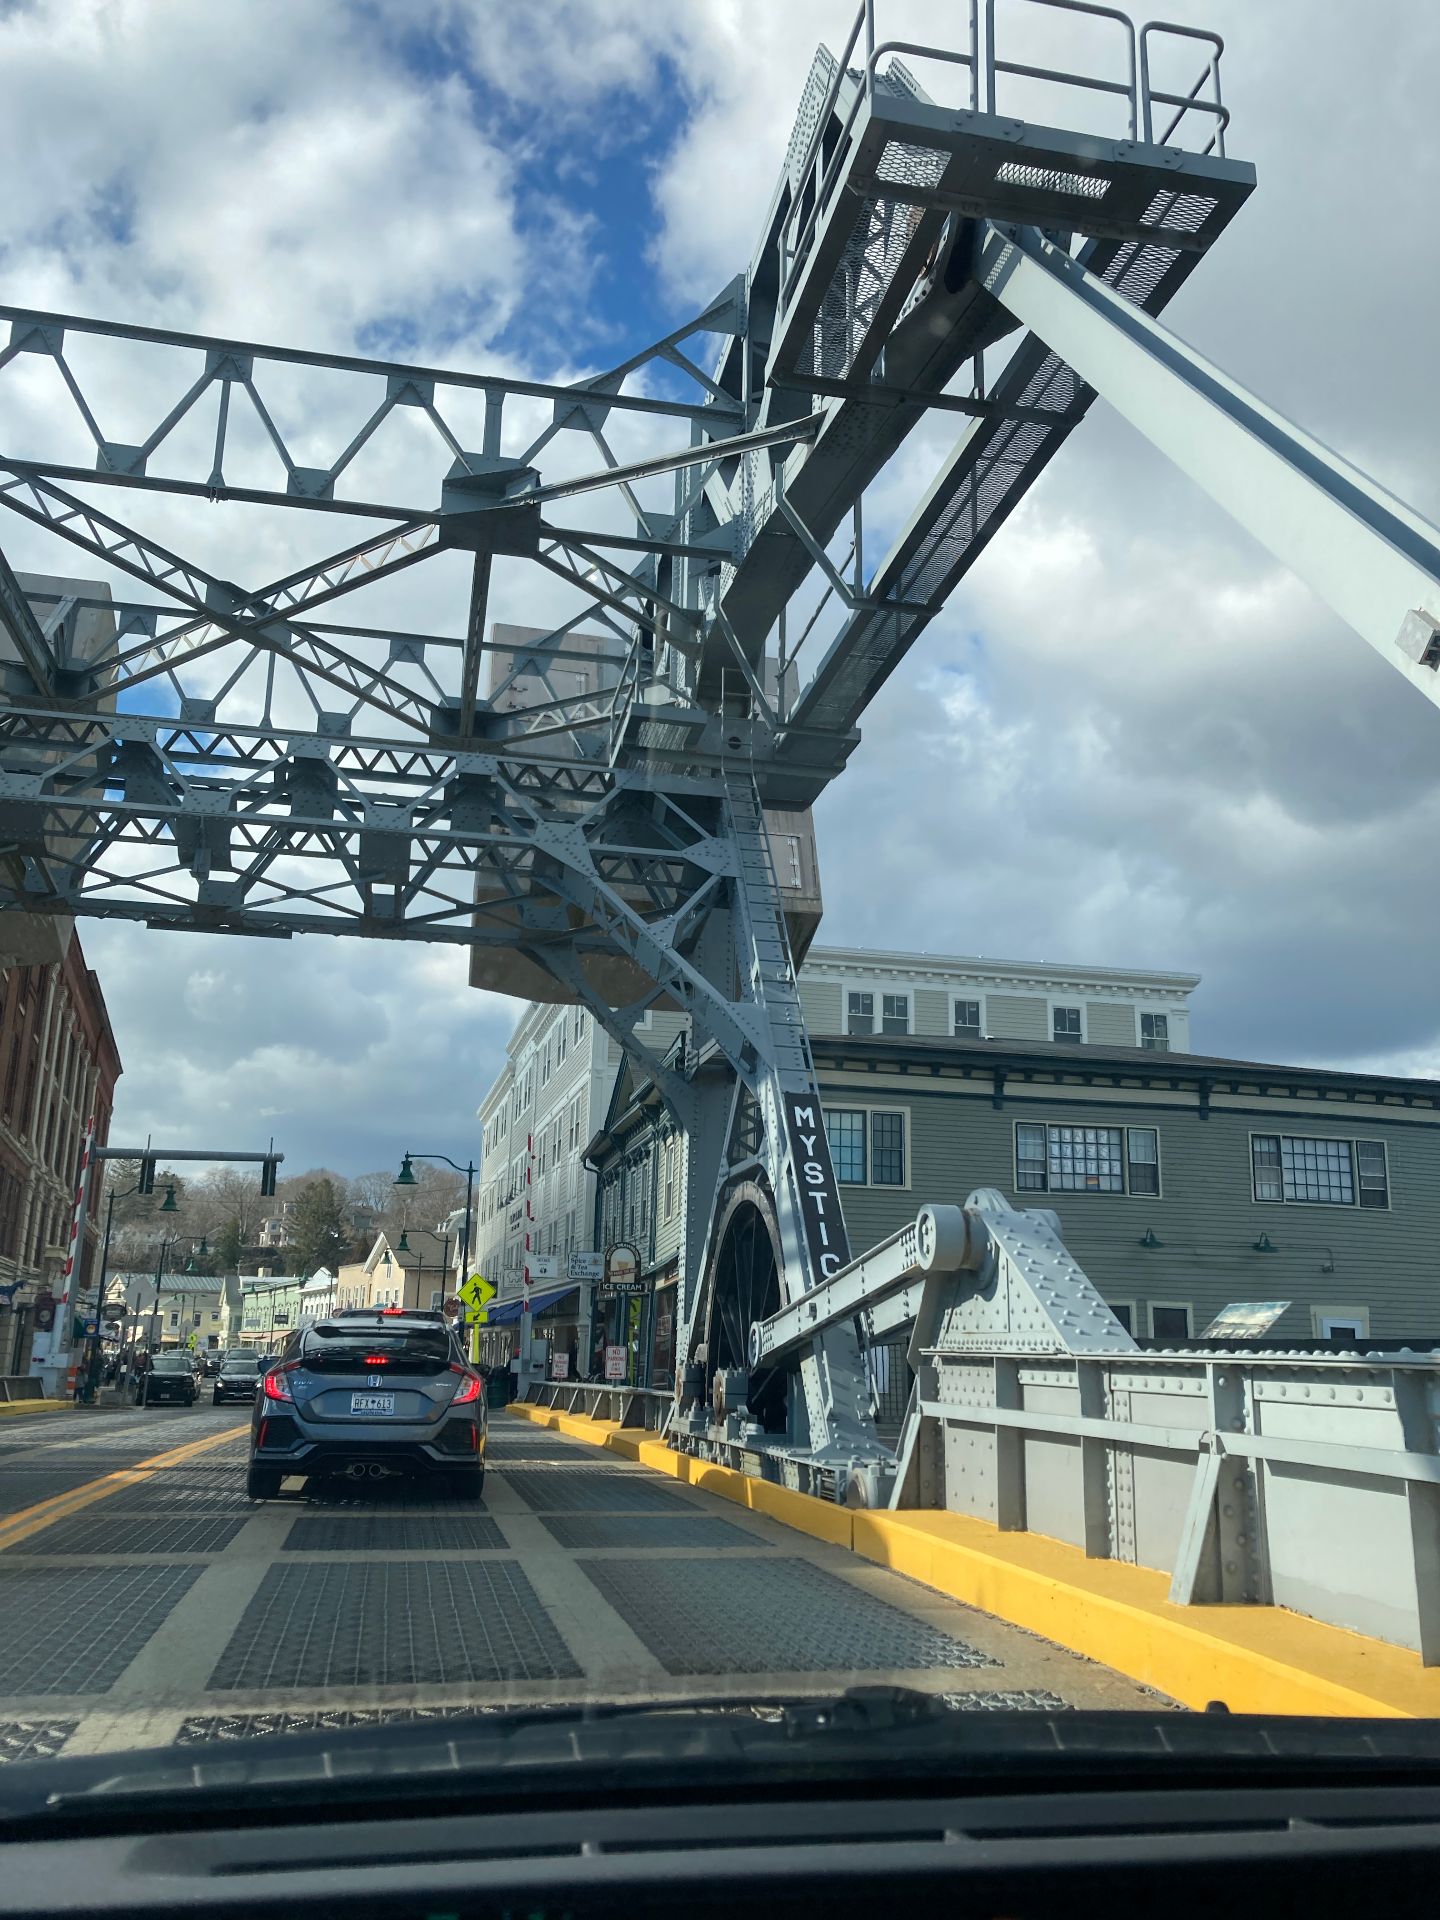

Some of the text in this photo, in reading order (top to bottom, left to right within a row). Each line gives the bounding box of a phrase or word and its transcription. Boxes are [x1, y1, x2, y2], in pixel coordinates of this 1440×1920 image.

[1051, 1128, 1108, 1143] BLACK
[1050, 1144, 1109, 1159] LIVES
[1051, 1160, 1120, 1174] MATTER
[794, 1105, 840, 1278] MYSTIC
[354, 1398, 391, 1409] RFX 613
